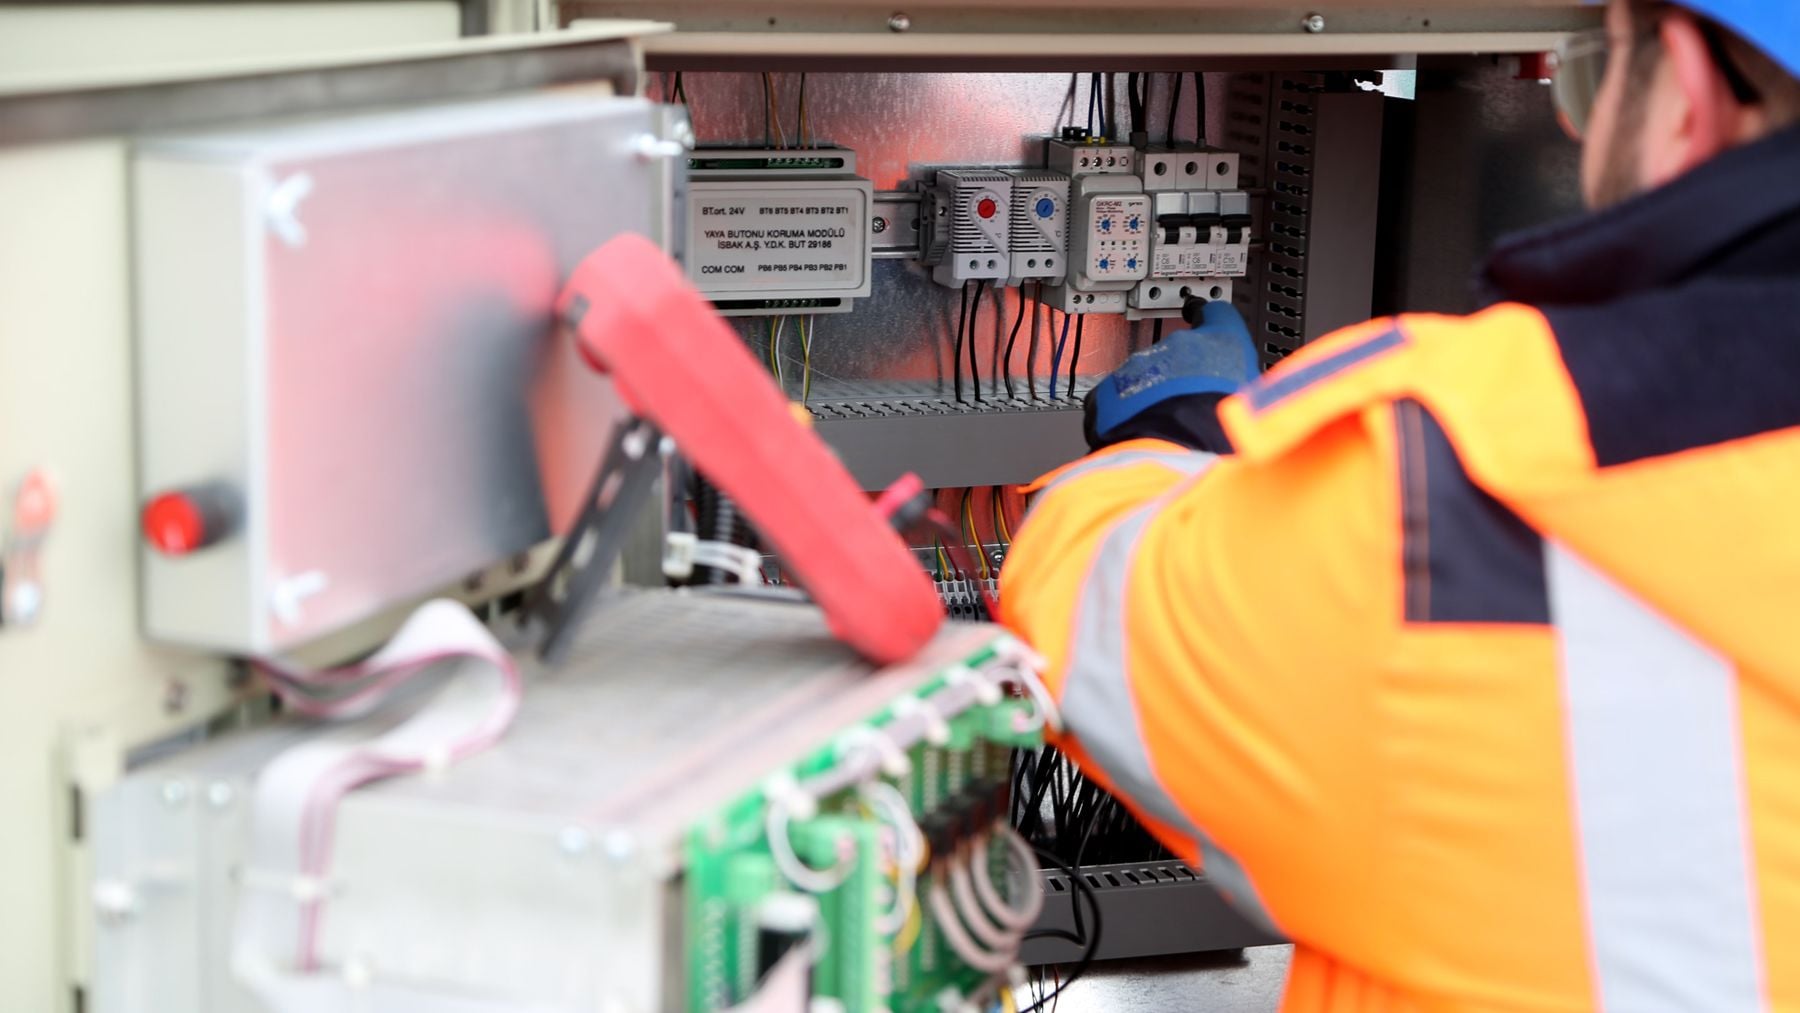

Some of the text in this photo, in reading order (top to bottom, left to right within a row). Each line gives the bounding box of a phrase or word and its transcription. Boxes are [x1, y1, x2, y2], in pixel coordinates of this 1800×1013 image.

[729, 207, 745, 215] 24V
[704, 228, 845, 238] YAYA BUTONU KORUMA MODÜLÜ
[718, 240, 743, 249] İSBAK
[745, 240, 761, 250] A.Ş.
[788, 240, 806, 248] BUT
[702, 266, 722, 274] COM
